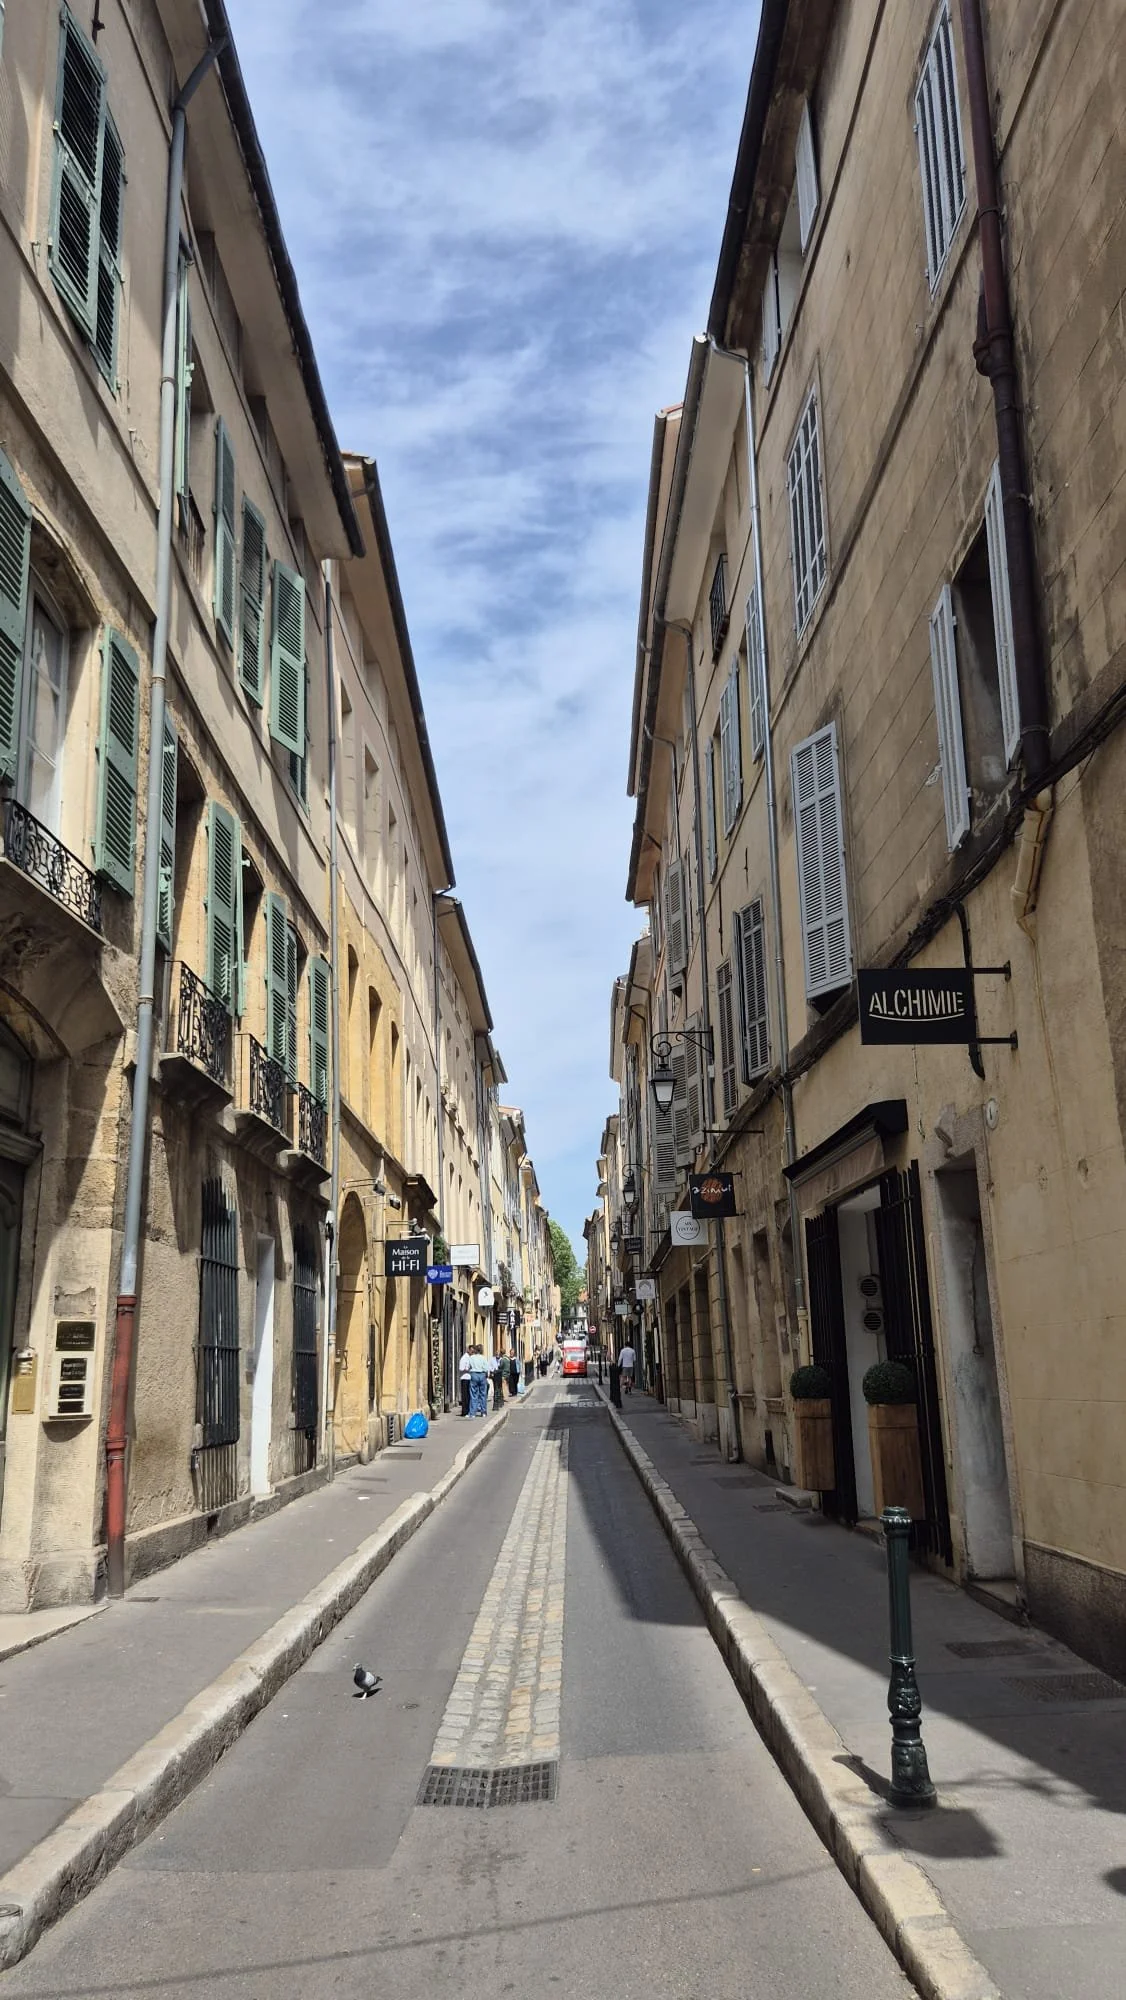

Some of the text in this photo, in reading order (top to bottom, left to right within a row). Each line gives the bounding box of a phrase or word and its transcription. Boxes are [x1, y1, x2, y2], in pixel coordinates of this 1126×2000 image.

[869, 989, 964, 1017] ALCHIMIE
[691, 1184, 731, 1194] azimut
[392, 1248, 420, 1256] Maison
[392, 1260, 420, 1272] HI-FI
